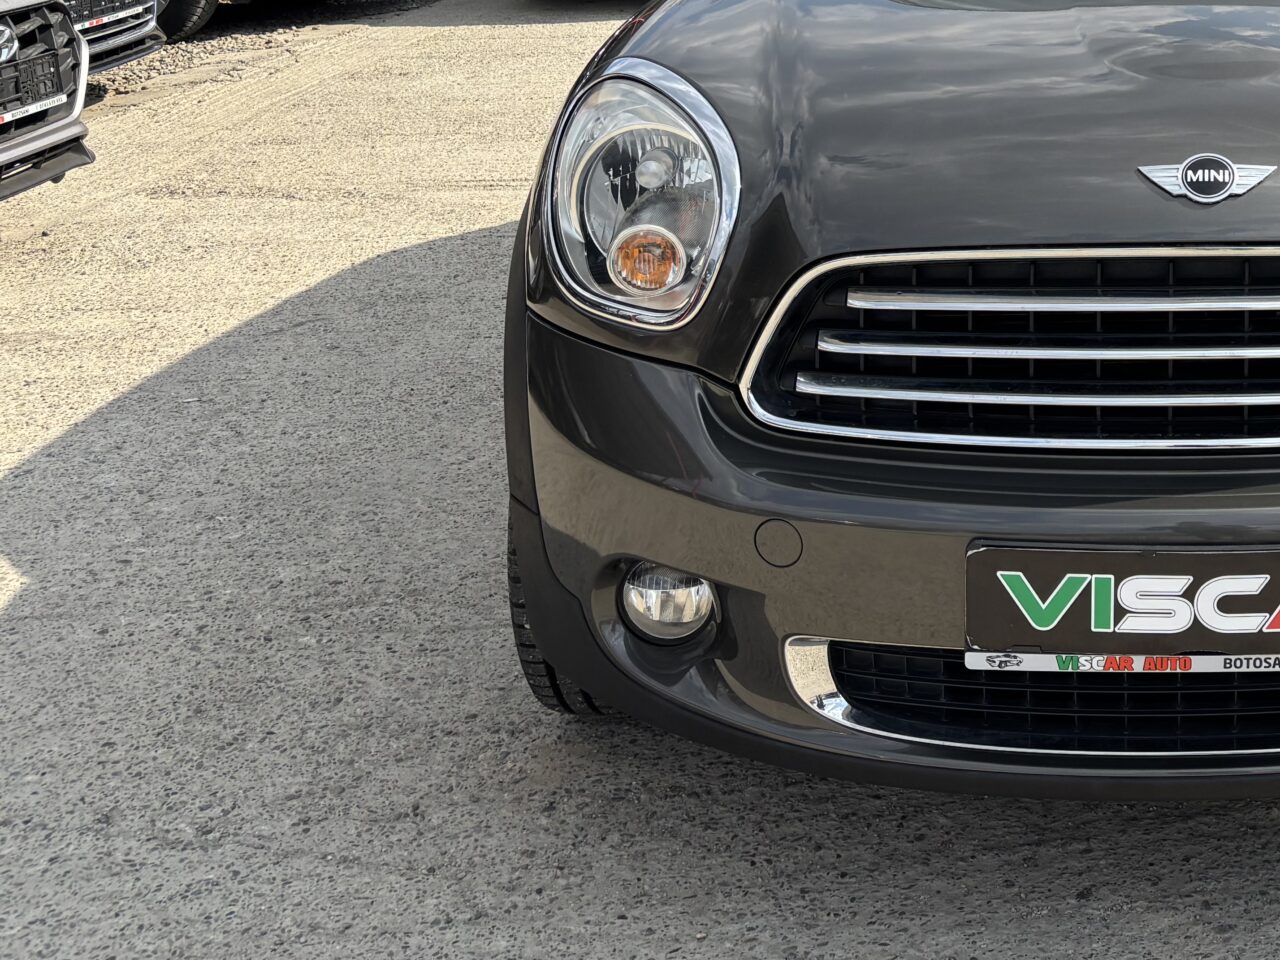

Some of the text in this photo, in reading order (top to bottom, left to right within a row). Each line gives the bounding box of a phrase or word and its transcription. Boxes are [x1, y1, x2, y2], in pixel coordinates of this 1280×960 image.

[1187, 169, 1230, 183] MINI
[1056, 654, 1134, 671] VISCAR
[1143, 656, 1192, 671] AUTO
